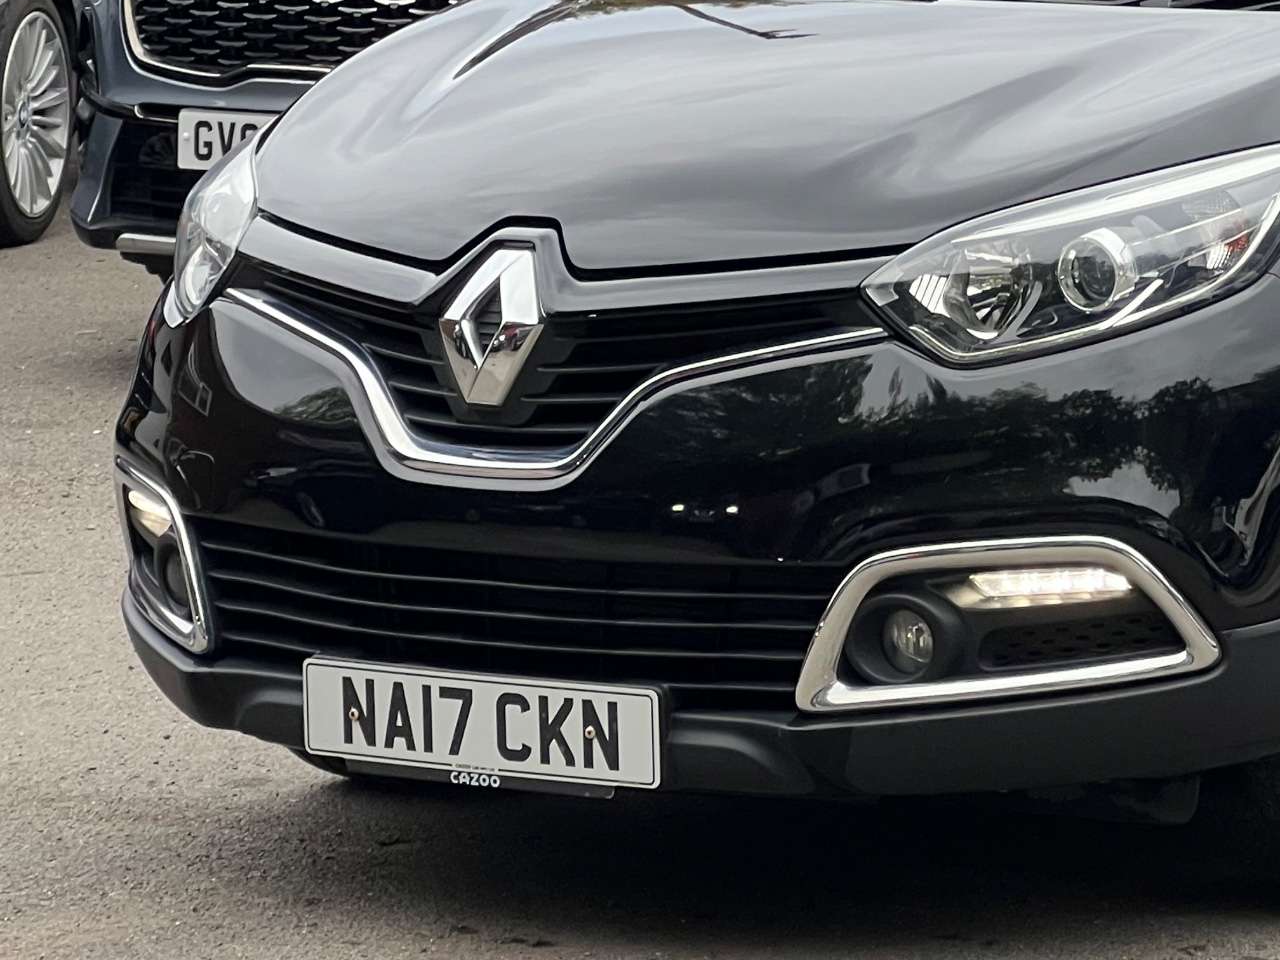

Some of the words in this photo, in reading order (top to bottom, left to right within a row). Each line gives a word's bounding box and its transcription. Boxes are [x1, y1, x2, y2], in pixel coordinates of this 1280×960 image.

[342, 675, 473, 756] NA17
[496, 693, 620, 771] CKN
[450, 771, 500, 788] CAZOO
